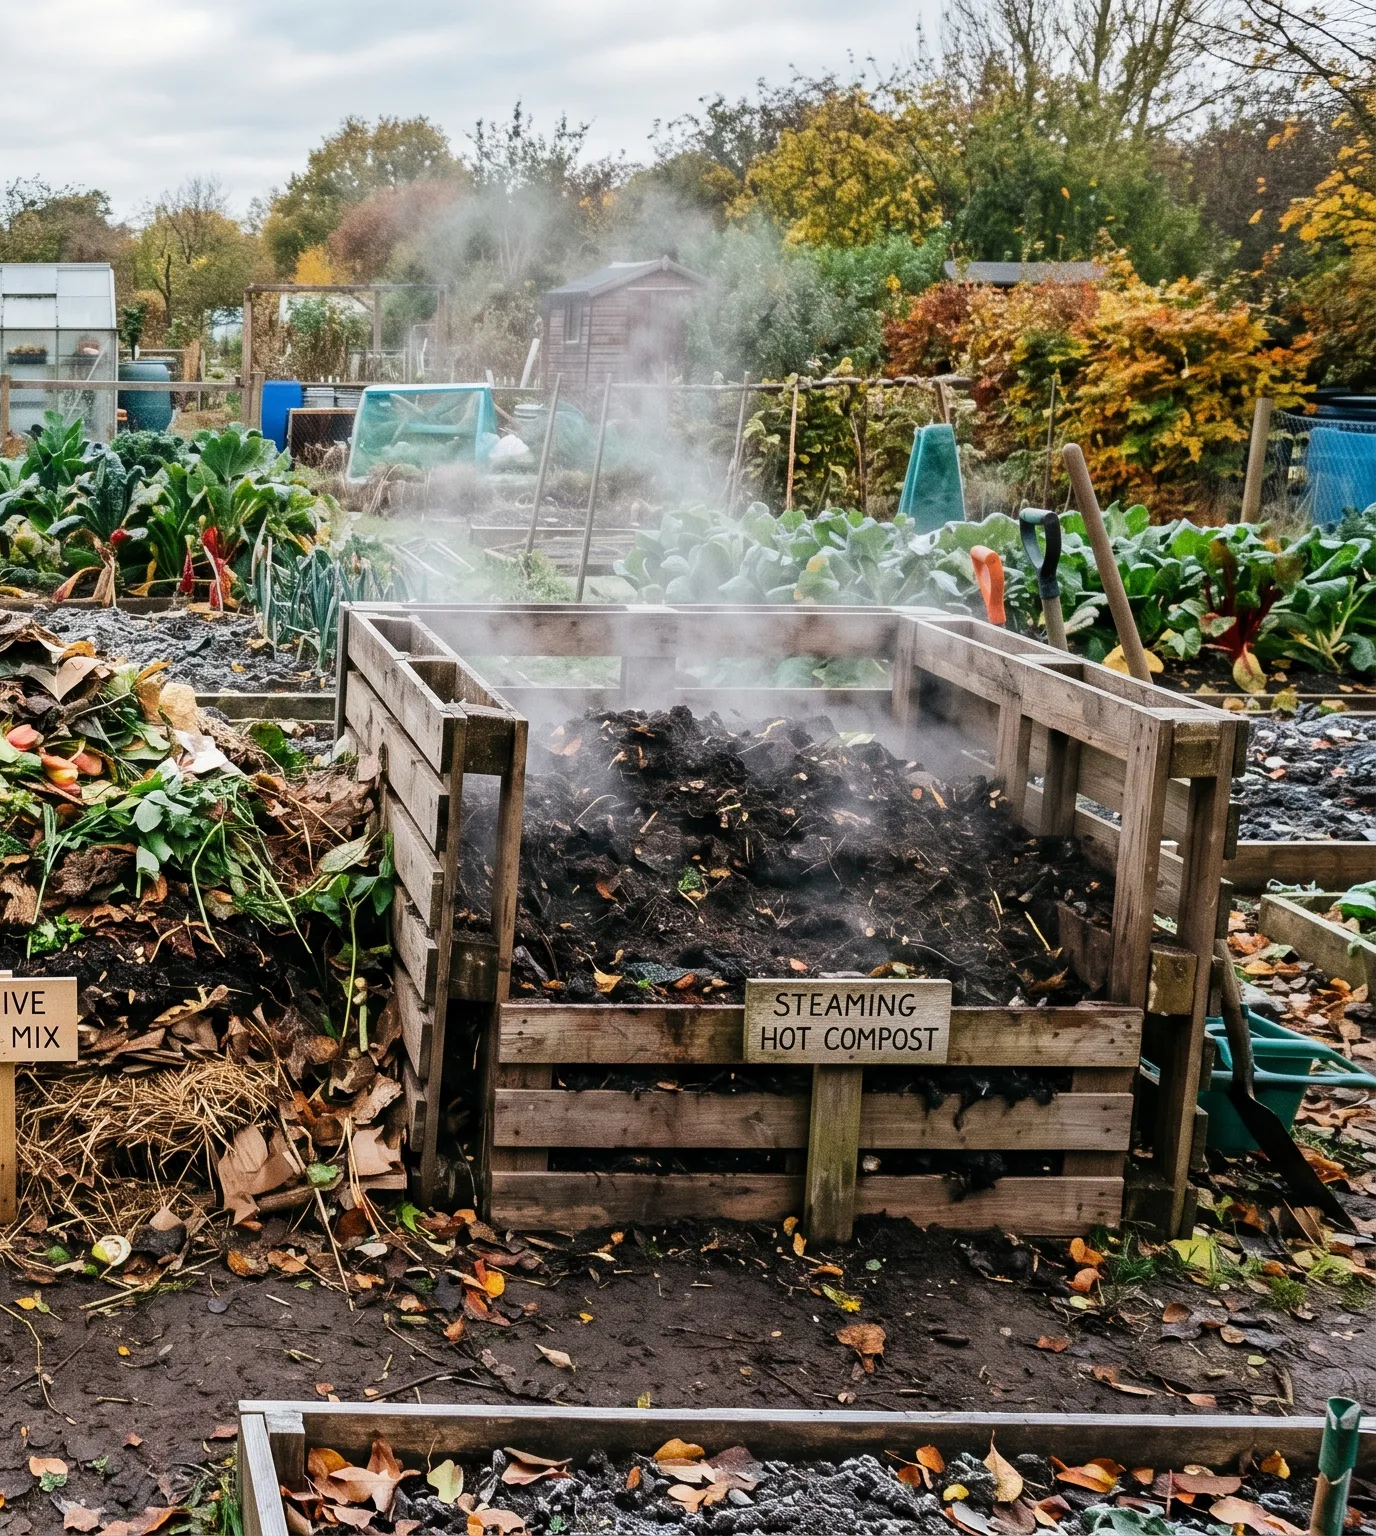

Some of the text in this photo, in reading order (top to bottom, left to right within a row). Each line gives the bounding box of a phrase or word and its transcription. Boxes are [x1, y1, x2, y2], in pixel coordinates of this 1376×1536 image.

[773, 992, 917, 1017] STEAMING
[12, 1026, 60, 1049] MIX
[761, 1026, 939, 1051] HOT COMPOST
